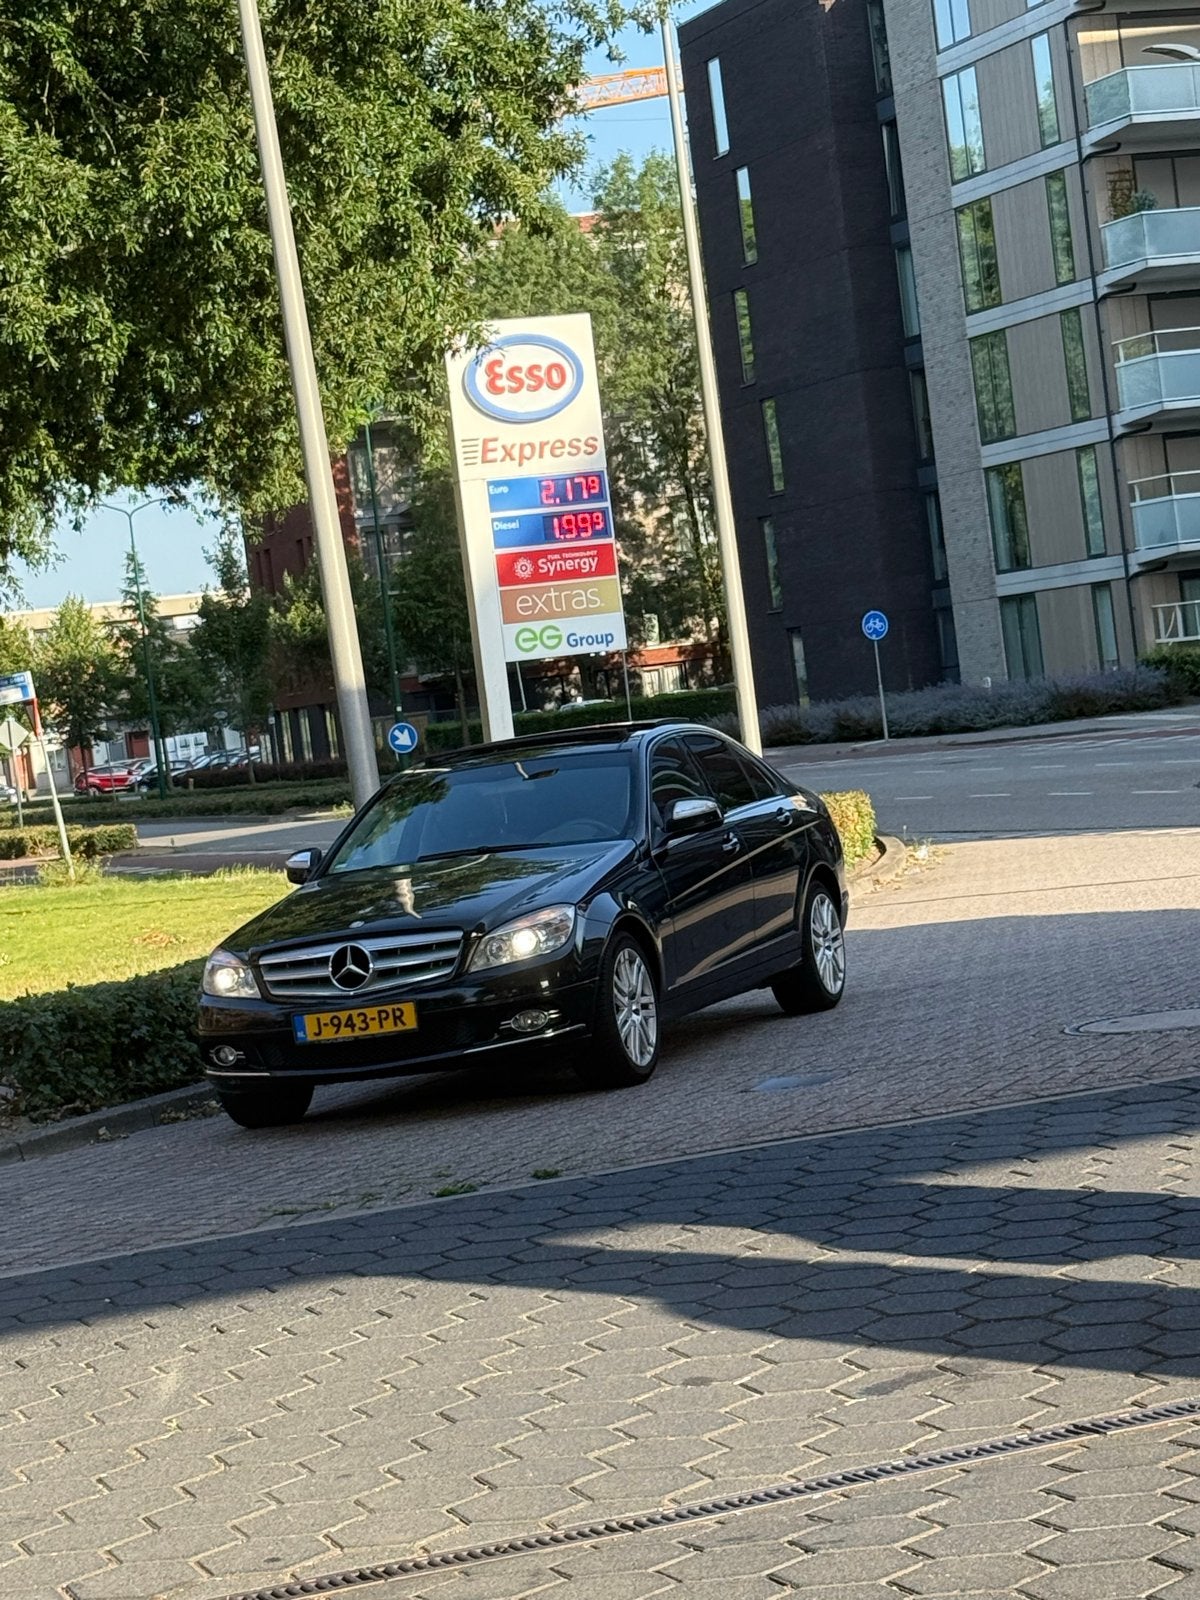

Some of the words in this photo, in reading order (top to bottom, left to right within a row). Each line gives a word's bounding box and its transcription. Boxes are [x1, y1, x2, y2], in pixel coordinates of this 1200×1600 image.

[485, 359, 567, 395] Esso
[481, 436, 599, 467] Express
[489, 483, 509, 495] Euro
[493, 519, 520, 531] Diesel
[538, 557, 599, 576] Synergy
[566, 632, 614, 648] Group
[313, 1007, 407, 1037] J-943-PR
